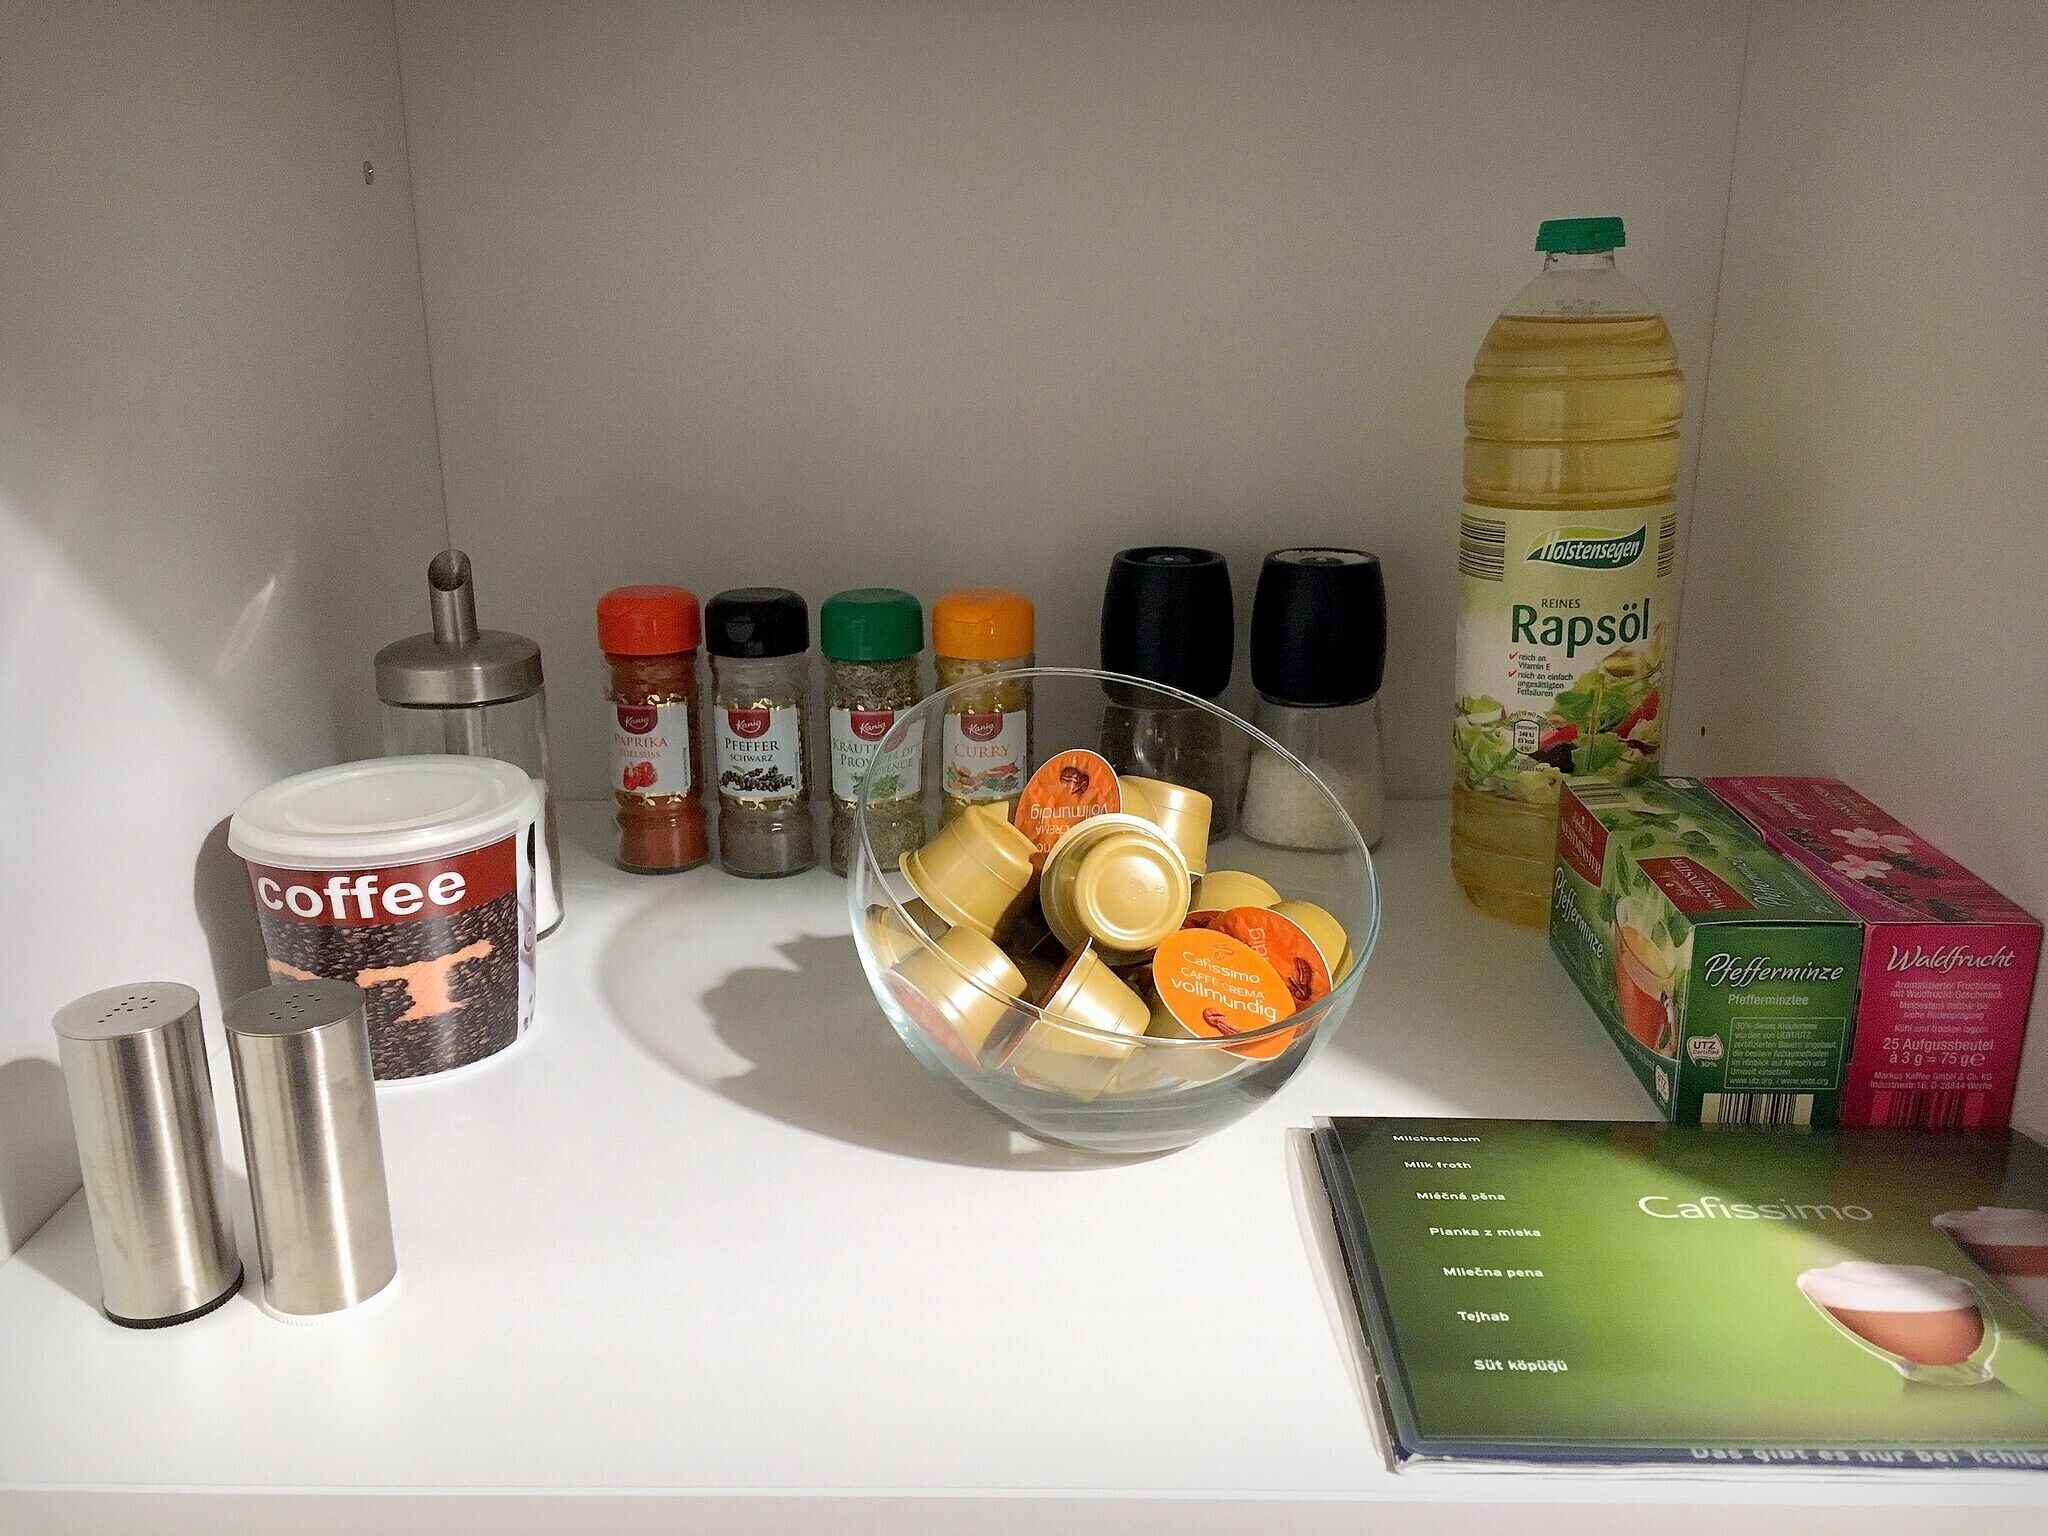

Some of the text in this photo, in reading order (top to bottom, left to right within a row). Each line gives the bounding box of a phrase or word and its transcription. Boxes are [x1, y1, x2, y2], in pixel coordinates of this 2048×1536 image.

[1539, 529, 1640, 563] Holstensegen
[1541, 598, 1580, 609] REINES
[1511, 597, 1650, 658] Rapsöl
[1518, 662, 1544, 670] Vitamin
[1517, 681, 1564, 690] ungesättigten
[1517, 688, 1553, 697] Fettsäuren
[614, 734, 668, 748] PAPRIKA
[725, 737, 779, 752] PFEFFER
[954, 743, 1011, 758] CURRY
[730, 753, 773, 763] SCHWARZ
[257, 869, 466, 920] coffee
[1554, 866, 1605, 958] Pfefferminze
[1887, 945, 2015, 974] Waldfrucht
[1182, 951, 1261, 984] Cafissimo
[1705, 953, 1844, 987] Pfefferminze
[1221, 982, 1265, 1001] CREMA
[1170, 977, 1278, 1023] vollmundig
[1728, 994, 1809, 1006] Pfefferminztee
[1693, 1041, 1716, 1050] UTZ
[1883, 1038, 1994, 1052] 25 Aufgussbeutel
[1890, 1051, 1898, 1064] à
[1901, 1052, 1910, 1064] 3
[1914, 1054, 1923, 1066] g
[1941, 1052, 1958, 1064] 75
[1874, 1072, 1903, 1080] Markus
[1392, 1134, 1481, 1143] Milchschaum
[1404, 1160, 1472, 1170] Milk froth
[1416, 1190, 1506, 1203] Mléčná pěna
[1638, 1196, 1873, 1222] Cafissimo
[1428, 1227, 1542, 1238] Pianka z mleka
[1443, 1266, 1544, 1280] Mliečna pena
[1457, 1311, 1510, 1324] Tejhab
[1474, 1358, 1568, 1375] Süt köpüğü
[1859, 1450, 1904, 1463] nur
